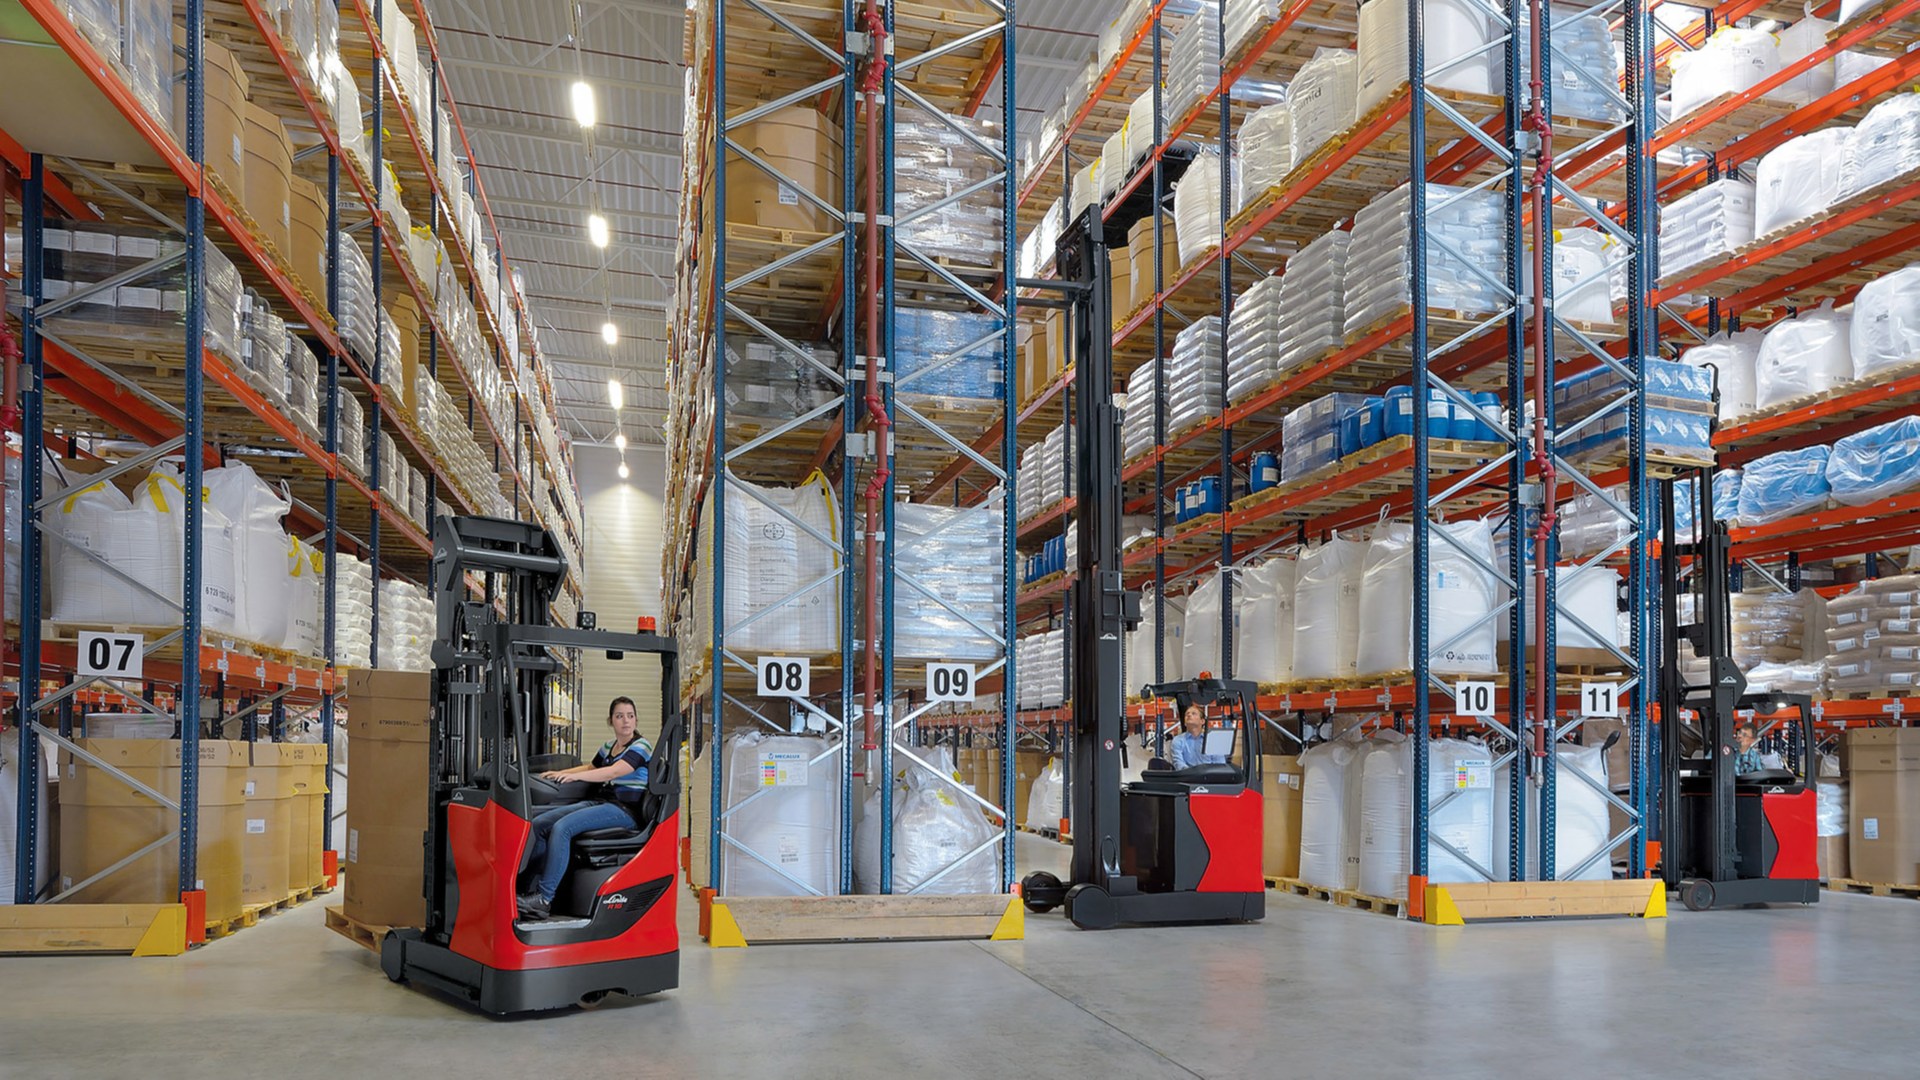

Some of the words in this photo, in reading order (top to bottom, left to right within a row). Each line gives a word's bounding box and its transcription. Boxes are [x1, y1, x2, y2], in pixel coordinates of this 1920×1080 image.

[88, 638, 135, 671] 07
[765, 662, 802, 691] 08
[933, 669, 968, 697] 09
[1461, 687, 1489, 711] 10
[1588, 688, 1611, 712] 11
